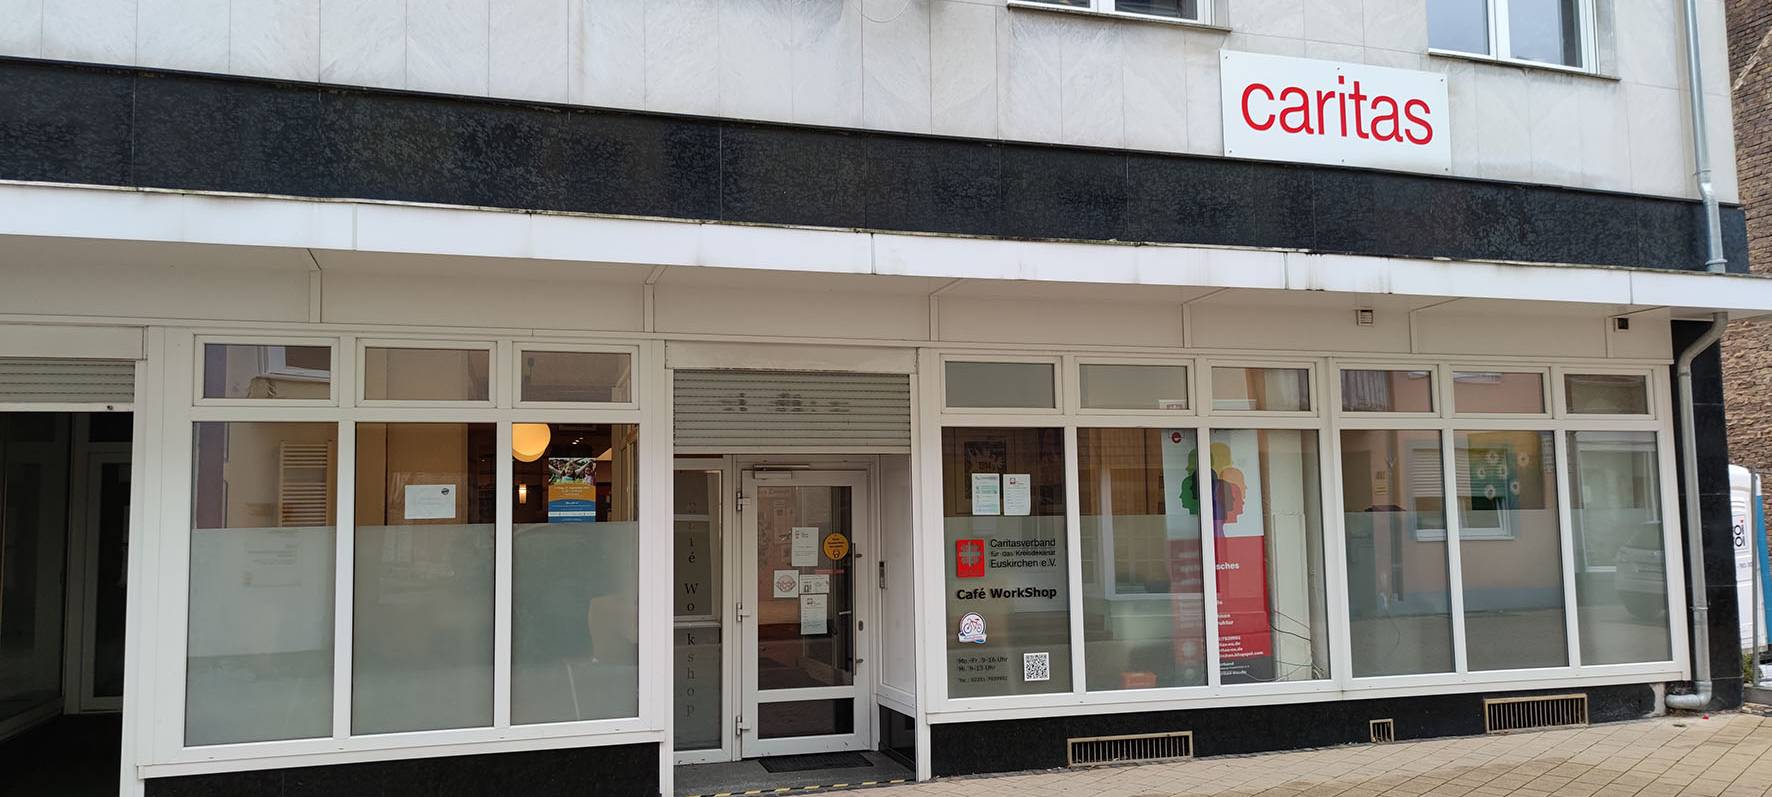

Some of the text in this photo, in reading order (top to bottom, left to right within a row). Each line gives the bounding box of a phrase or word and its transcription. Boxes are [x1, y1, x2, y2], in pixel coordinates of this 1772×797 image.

[1241, 75, 1433, 145] caritas
[991, 538, 1056, 548] Caritasverband
[991, 558, 1057, 568] Euskirchen e.V.
[956, 587, 1057, 600] Café WorkShop
